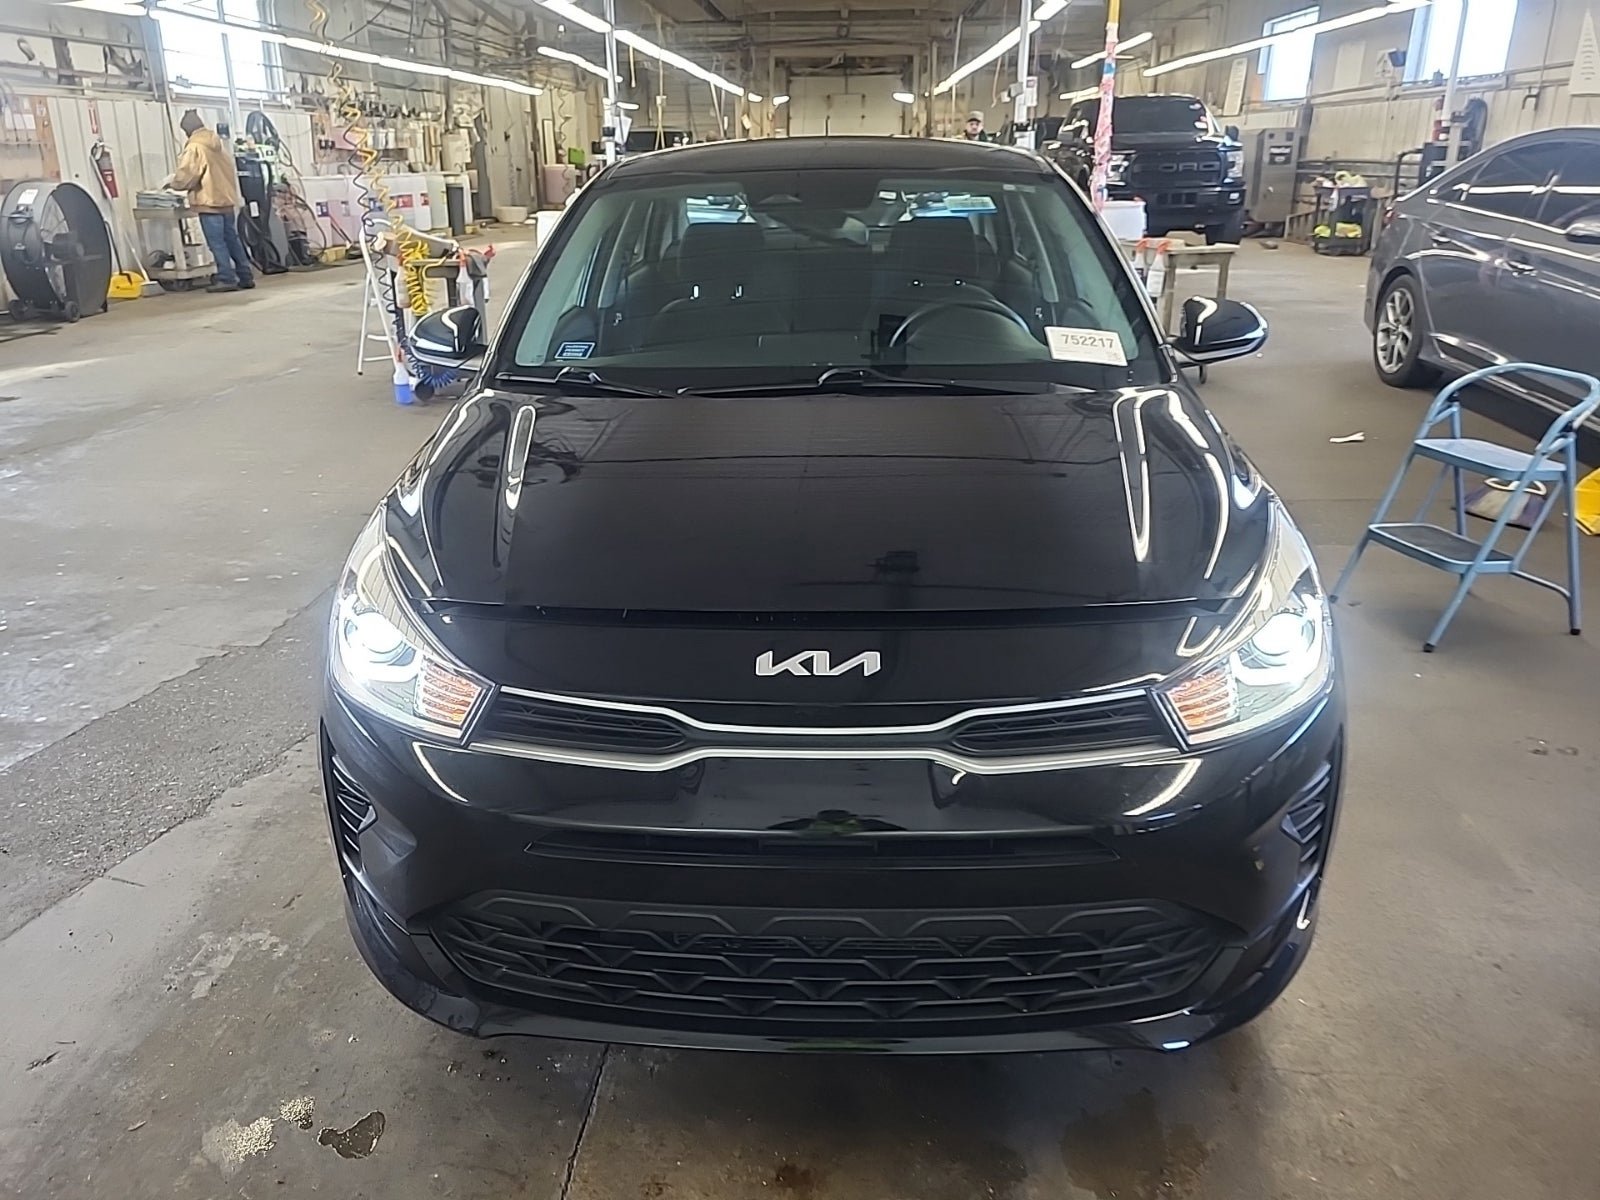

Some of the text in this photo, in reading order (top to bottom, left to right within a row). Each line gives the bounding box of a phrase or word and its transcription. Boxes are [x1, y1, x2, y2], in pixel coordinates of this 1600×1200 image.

[1133, 162, 1220, 173] FORD
[1061, 334, 1114, 348] 752217
[755, 650, 881, 676] KIA
